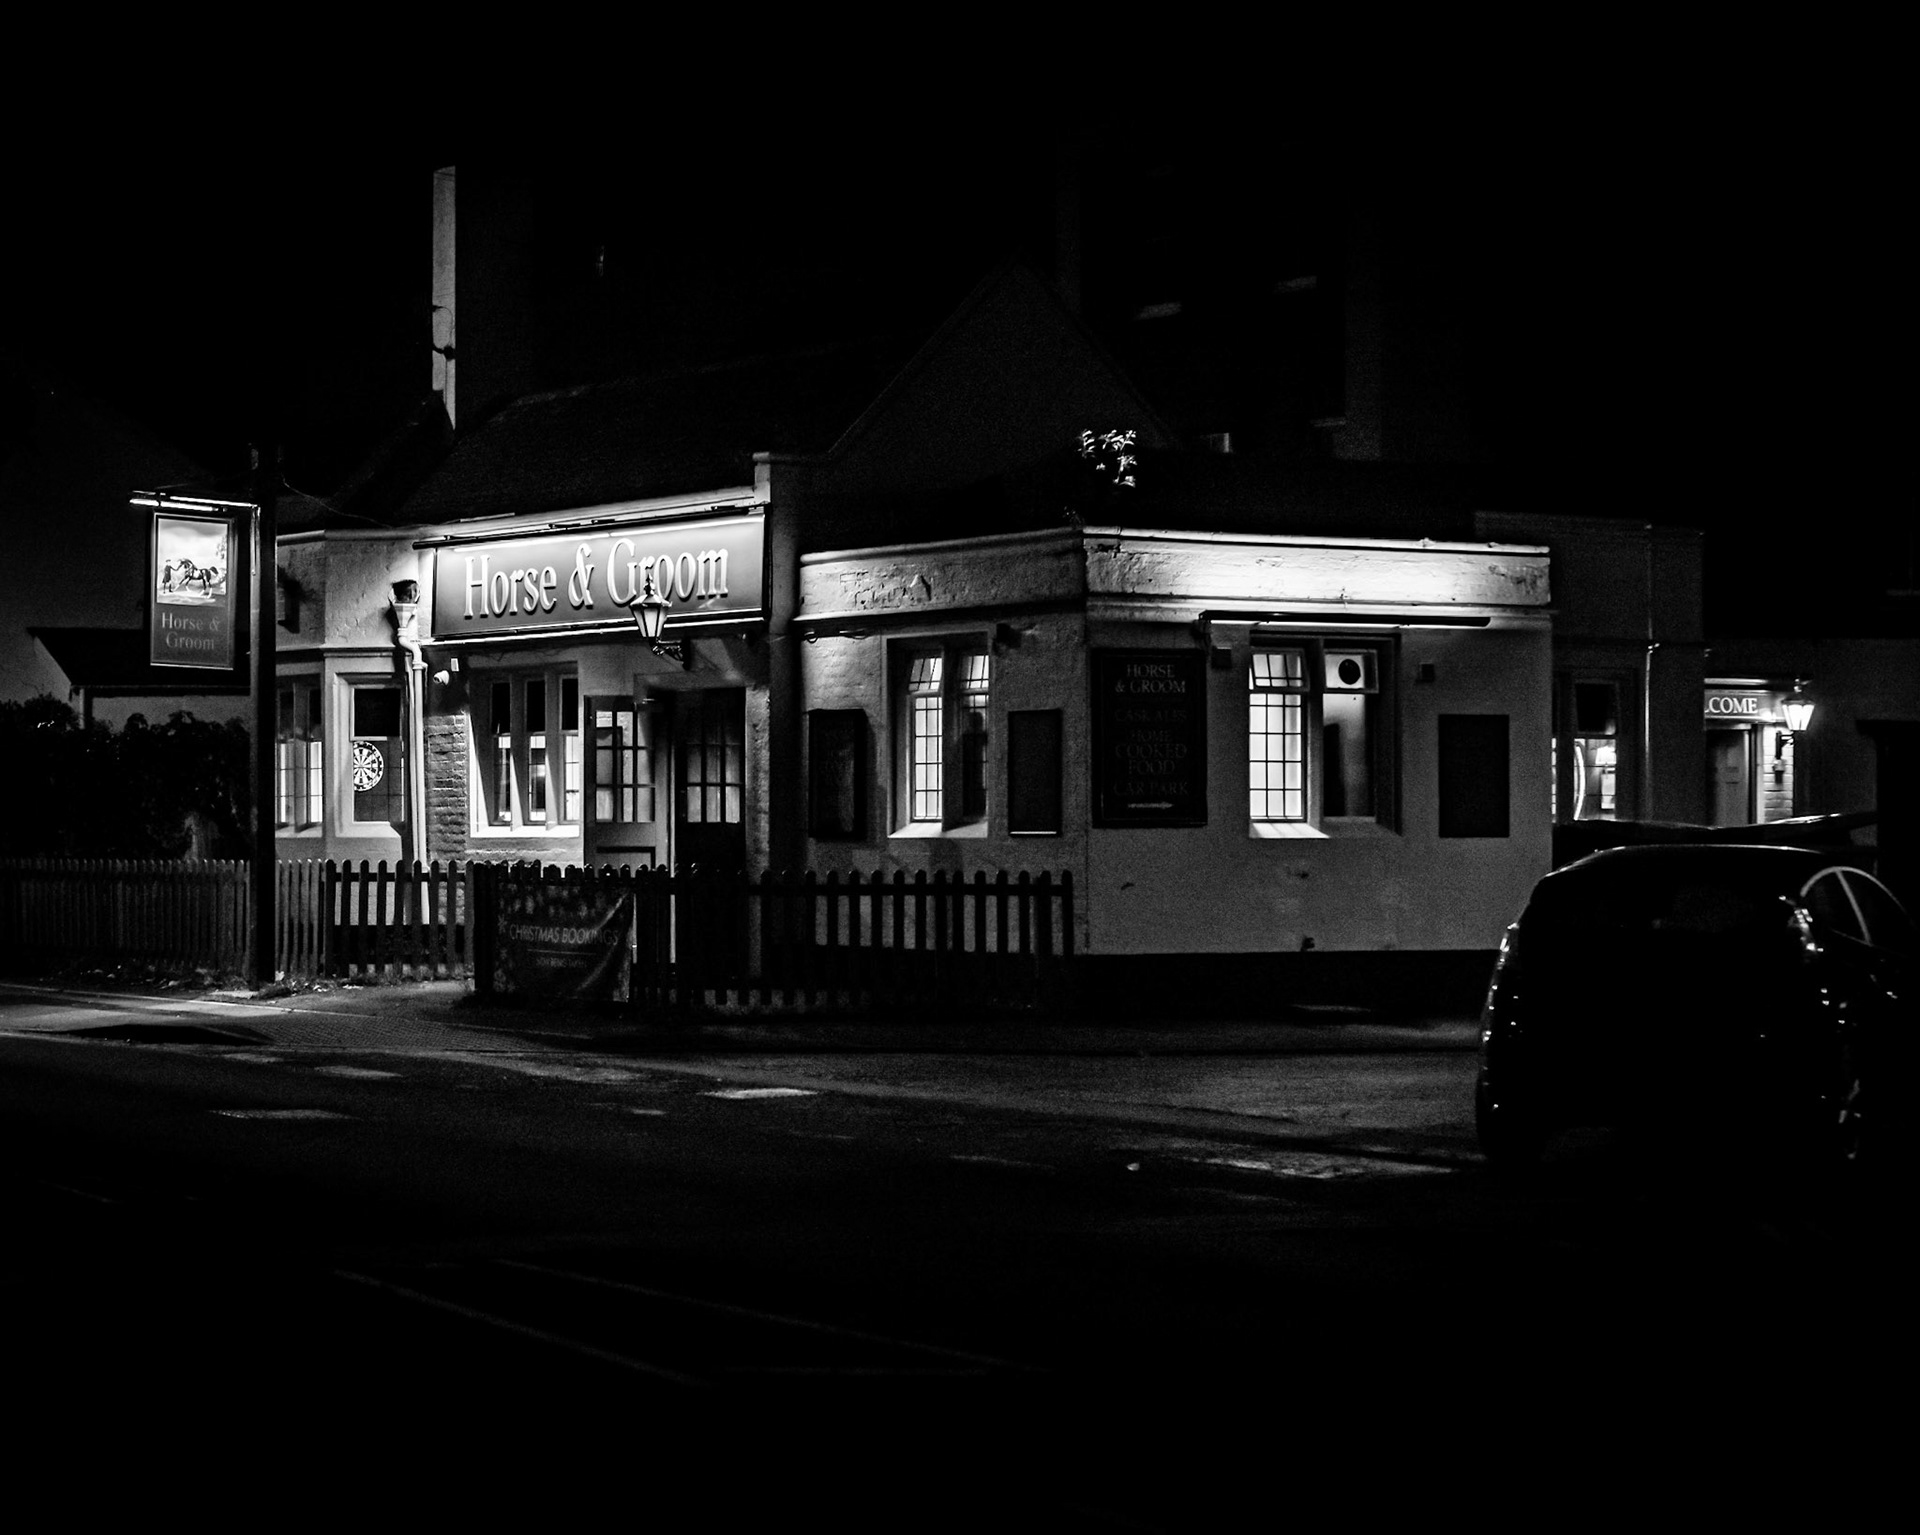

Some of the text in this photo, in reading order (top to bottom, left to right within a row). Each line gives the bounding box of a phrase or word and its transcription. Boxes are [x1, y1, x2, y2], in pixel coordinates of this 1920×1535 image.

[463, 538, 729, 618] Horse & Groom
[161, 612, 221, 632] Horse &
[165, 631, 215, 650] Groom
[1126, 663, 1176, 678] HORSE
[1114, 678, 1186, 693] & GROOM
[1704, 697, 1758, 714] COME
[1130, 728, 1172, 742] HOME
[1114, 743, 1188, 759] COOKED
[1128, 758, 1176, 775] FOOD
[1113, 780, 1189, 796] CAR PARK
[509, 923, 618, 946] CHRISTMAS BOOKINGS
